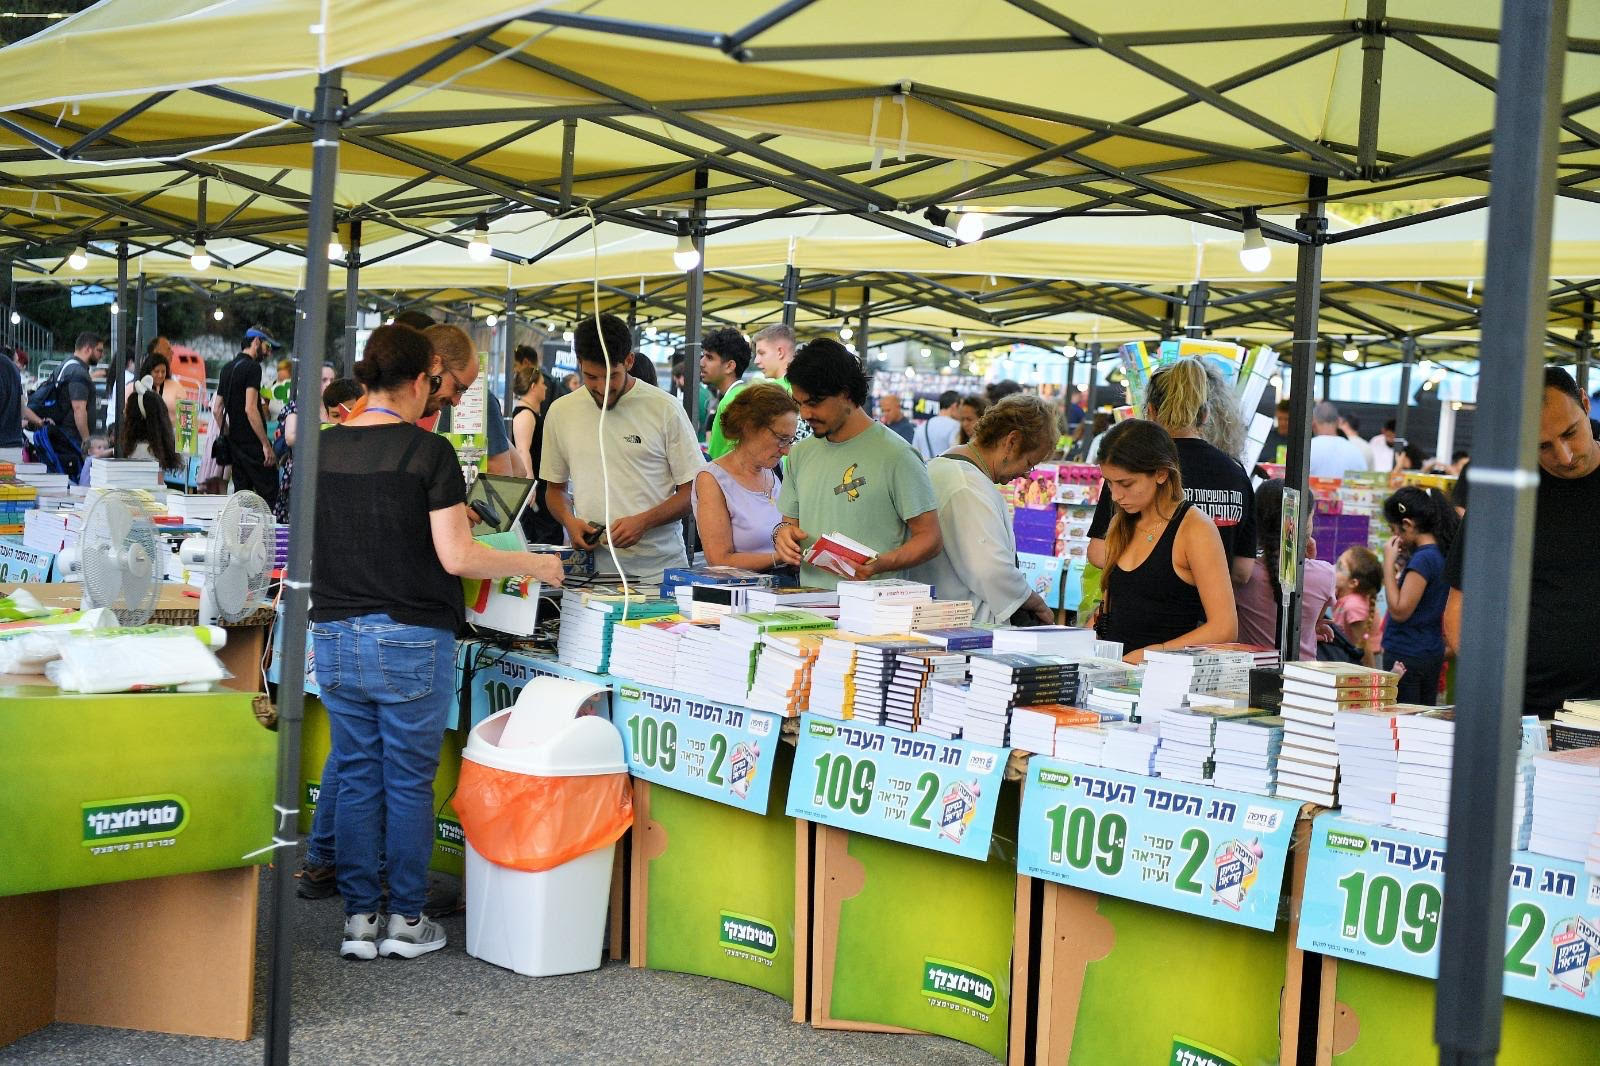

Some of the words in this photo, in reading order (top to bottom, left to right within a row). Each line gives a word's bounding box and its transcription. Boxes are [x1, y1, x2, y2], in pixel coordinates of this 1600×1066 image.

[1195, 488, 1229, 503] המשפחות
[0, 545, 13, 558] העבר
[495, 658, 527, 680] העברי
[642, 690, 681, 714] העברי
[685, 700, 723, 723] הספר
[725, 711, 744, 728] חג
[627, 715, 677, 772] 109
[687, 740, 705, 751] ספרי
[837, 726, 885, 751] העברי
[891, 737, 936, 761] הספר
[680, 751, 704, 764] קריאה
[708, 733, 727, 786] 2
[939, 748, 961, 766] חג
[687, 765, 704, 777] ועיון
[815, 752, 876, 815] 109
[887, 779, 911, 791] ספרי
[1073, 776, 1135, 803] העברי
[877, 791, 909, 806] קריאה
[909, 772, 940, 830] 2
[1144, 788, 1203, 816] הספר
[87, 804, 178, 835] סטימצקי
[884, 806, 905, 820] ועיון
[1207, 801, 1236, 823] חג
[1248, 812, 1267, 823] חיפה
[1047, 804, 1127, 876] 109
[1143, 835, 1174, 850] ספרי
[1329, 834, 1364, 849] סטימצקי
[1131, 848, 1172, 868] קריאה
[1174, 829, 1210, 894] 2
[1235, 844, 1253, 866] חיפה
[1370, 839, 1446, 872] העברי
[1142, 867, 1169, 883] ועיון
[1220, 862, 1240, 877] בסימן
[1540, 868, 1576, 897] חג
[1339, 871, 1442, 954] 109
[723, 920, 774, 947] סטימצקי
[1504, 902, 1546, 977] 2
[1560, 941, 1585, 958] בסימן
[1558, 952, 1587, 971] קריאה
[928, 968, 992, 1001] סטימצקי
[927, 998, 960, 1011] סטימצקי
